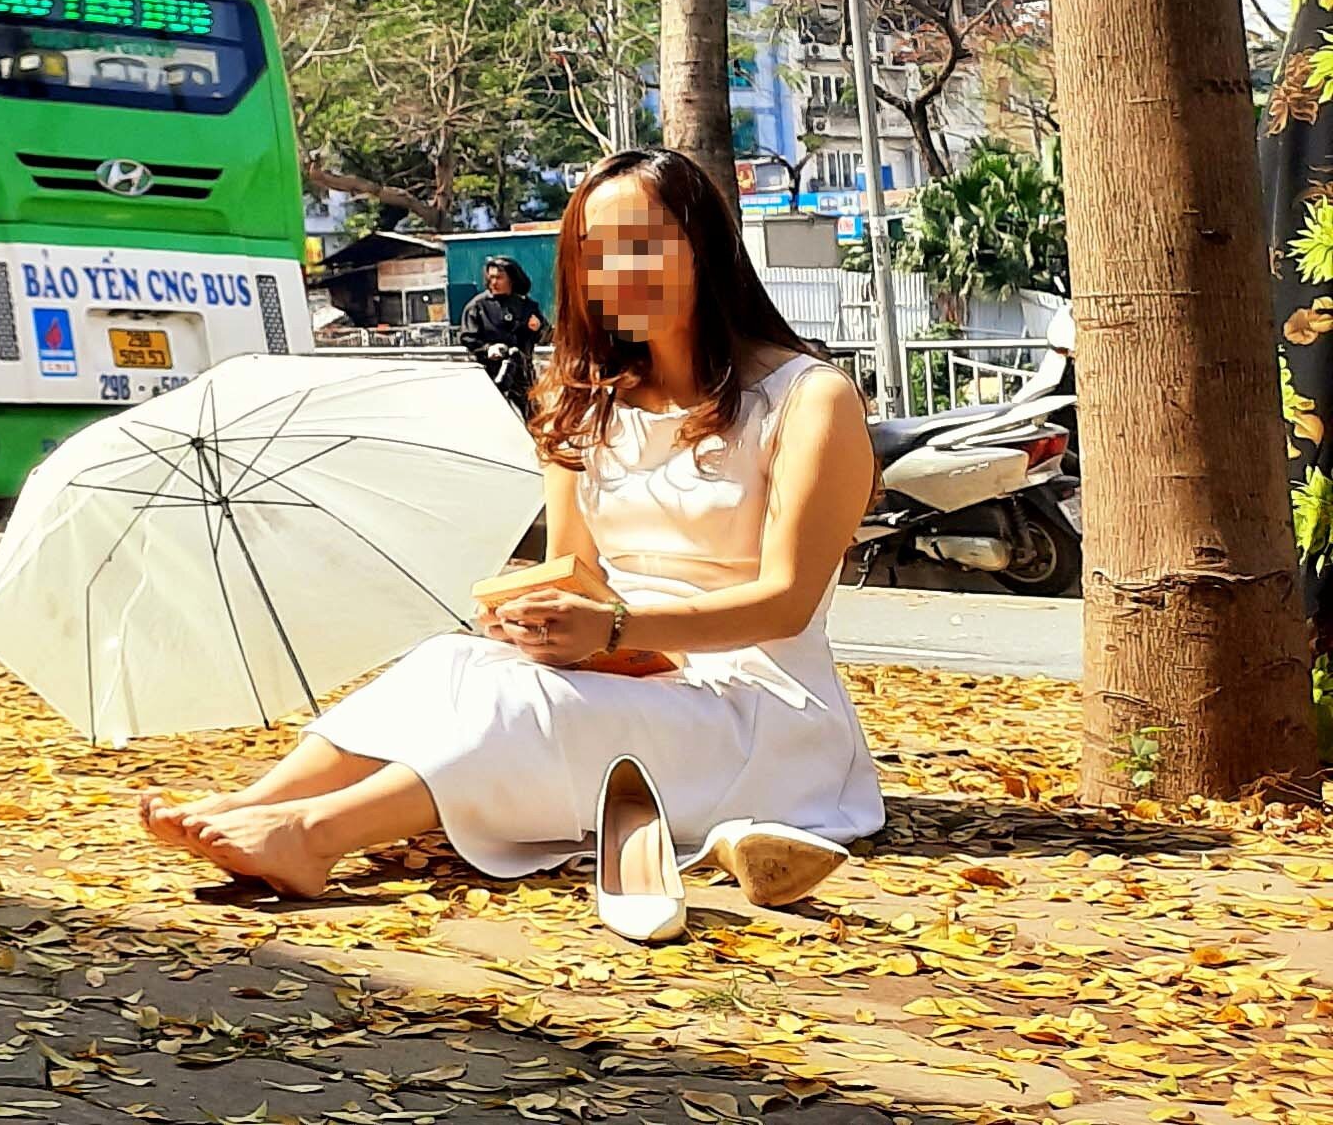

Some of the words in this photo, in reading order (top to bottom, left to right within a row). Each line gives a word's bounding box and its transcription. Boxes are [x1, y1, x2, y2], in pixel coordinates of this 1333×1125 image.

[146, 269, 198, 303] CNG
[200, 273, 252, 307] BUS
[99, 375, 131, 400] 29B
